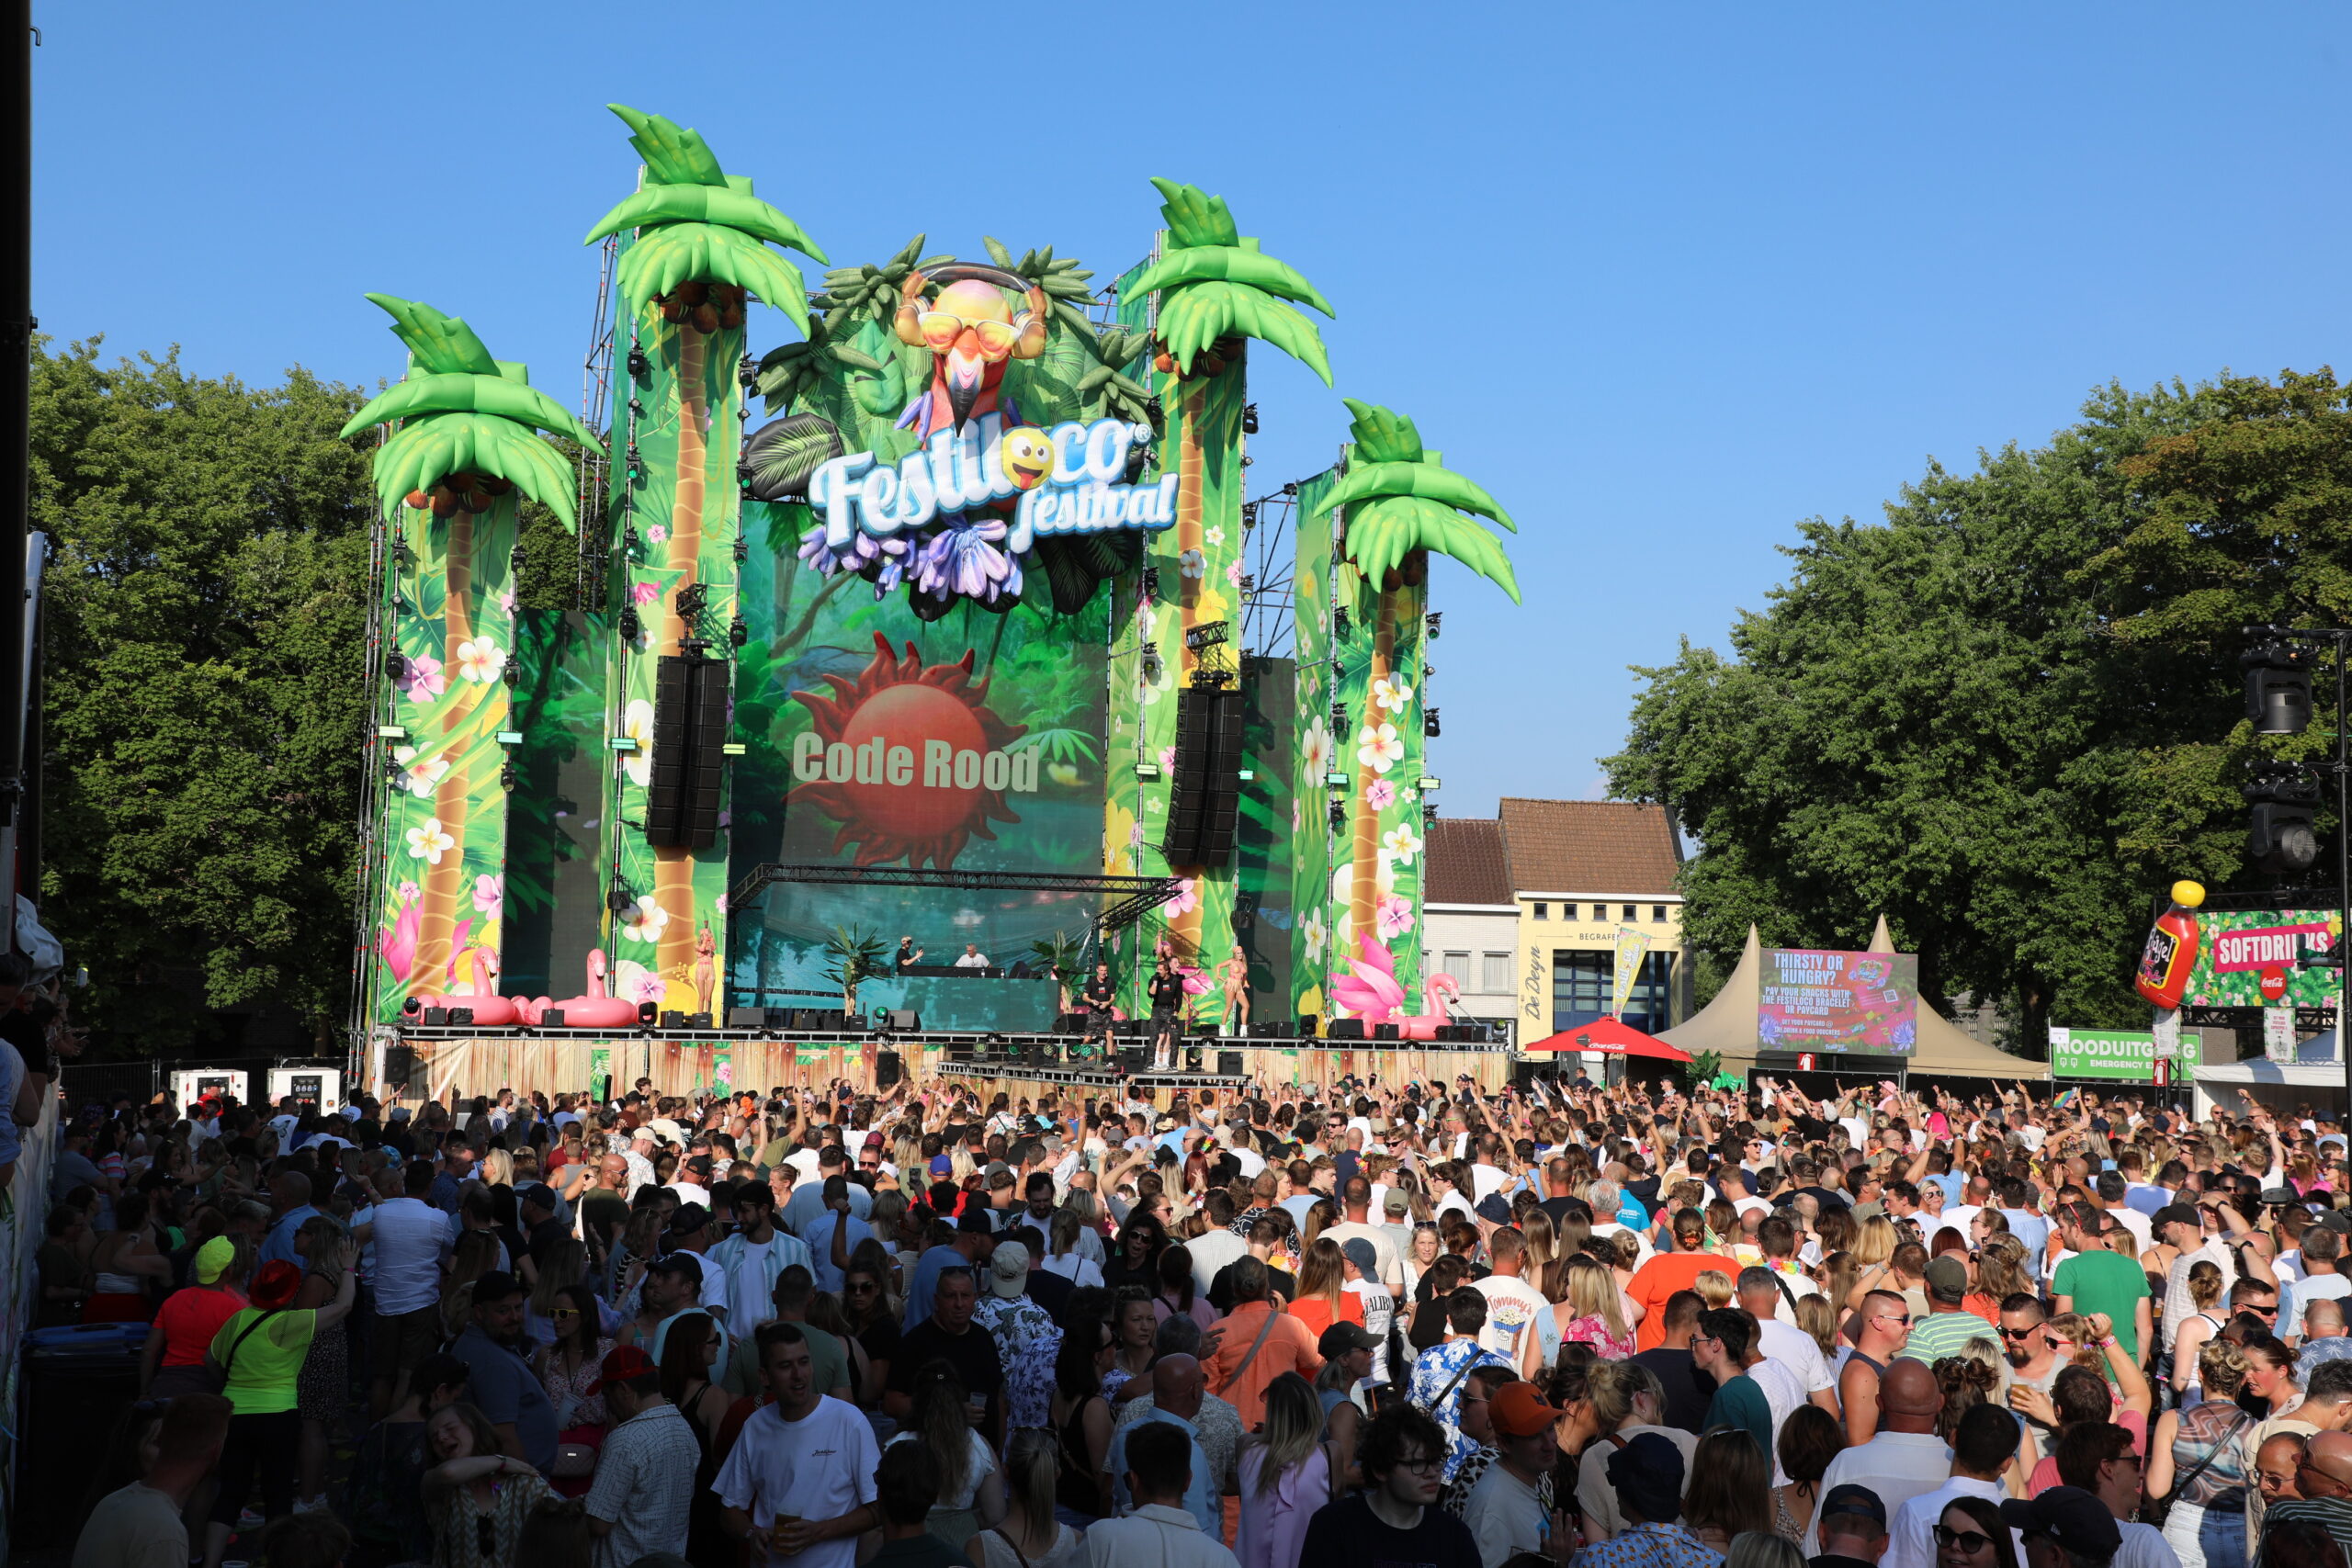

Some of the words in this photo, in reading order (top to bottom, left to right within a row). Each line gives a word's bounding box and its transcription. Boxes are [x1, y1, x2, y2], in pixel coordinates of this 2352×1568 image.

[1005, 471, 1180, 555] festival
[793, 732, 914, 785] Code
[923, 738, 1039, 793] Rood
[2219, 931, 2328, 964] SOFTDRIKS
[1525, 945, 1546, 994] Deyn
[1774, 953, 1824, 969] THIRSTY
[1826, 955, 1844, 971] OR
[1781, 968, 1837, 986] HUNGRY?
[1762, 995, 1775, 1004] THE
[1776, 996, 1814, 1006] FESTILOCO
[1815, 998, 1850, 1008] BRACELET
[1765, 986, 1779, 996] PAY
[1780, 987, 1799, 997] YOUR
[1801, 987, 1829, 998] SNACKS
[1831, 989, 1850, 998] WITH
[1525, 996, 1541, 1021] De
[1785, 1006, 1794, 1014] OR
[1796, 1006, 1829, 1016] PAYCARD
[2056, 1038, 2196, 1059] NOODUITGG
[2089, 1059, 2143, 1069] EMERGENCY
